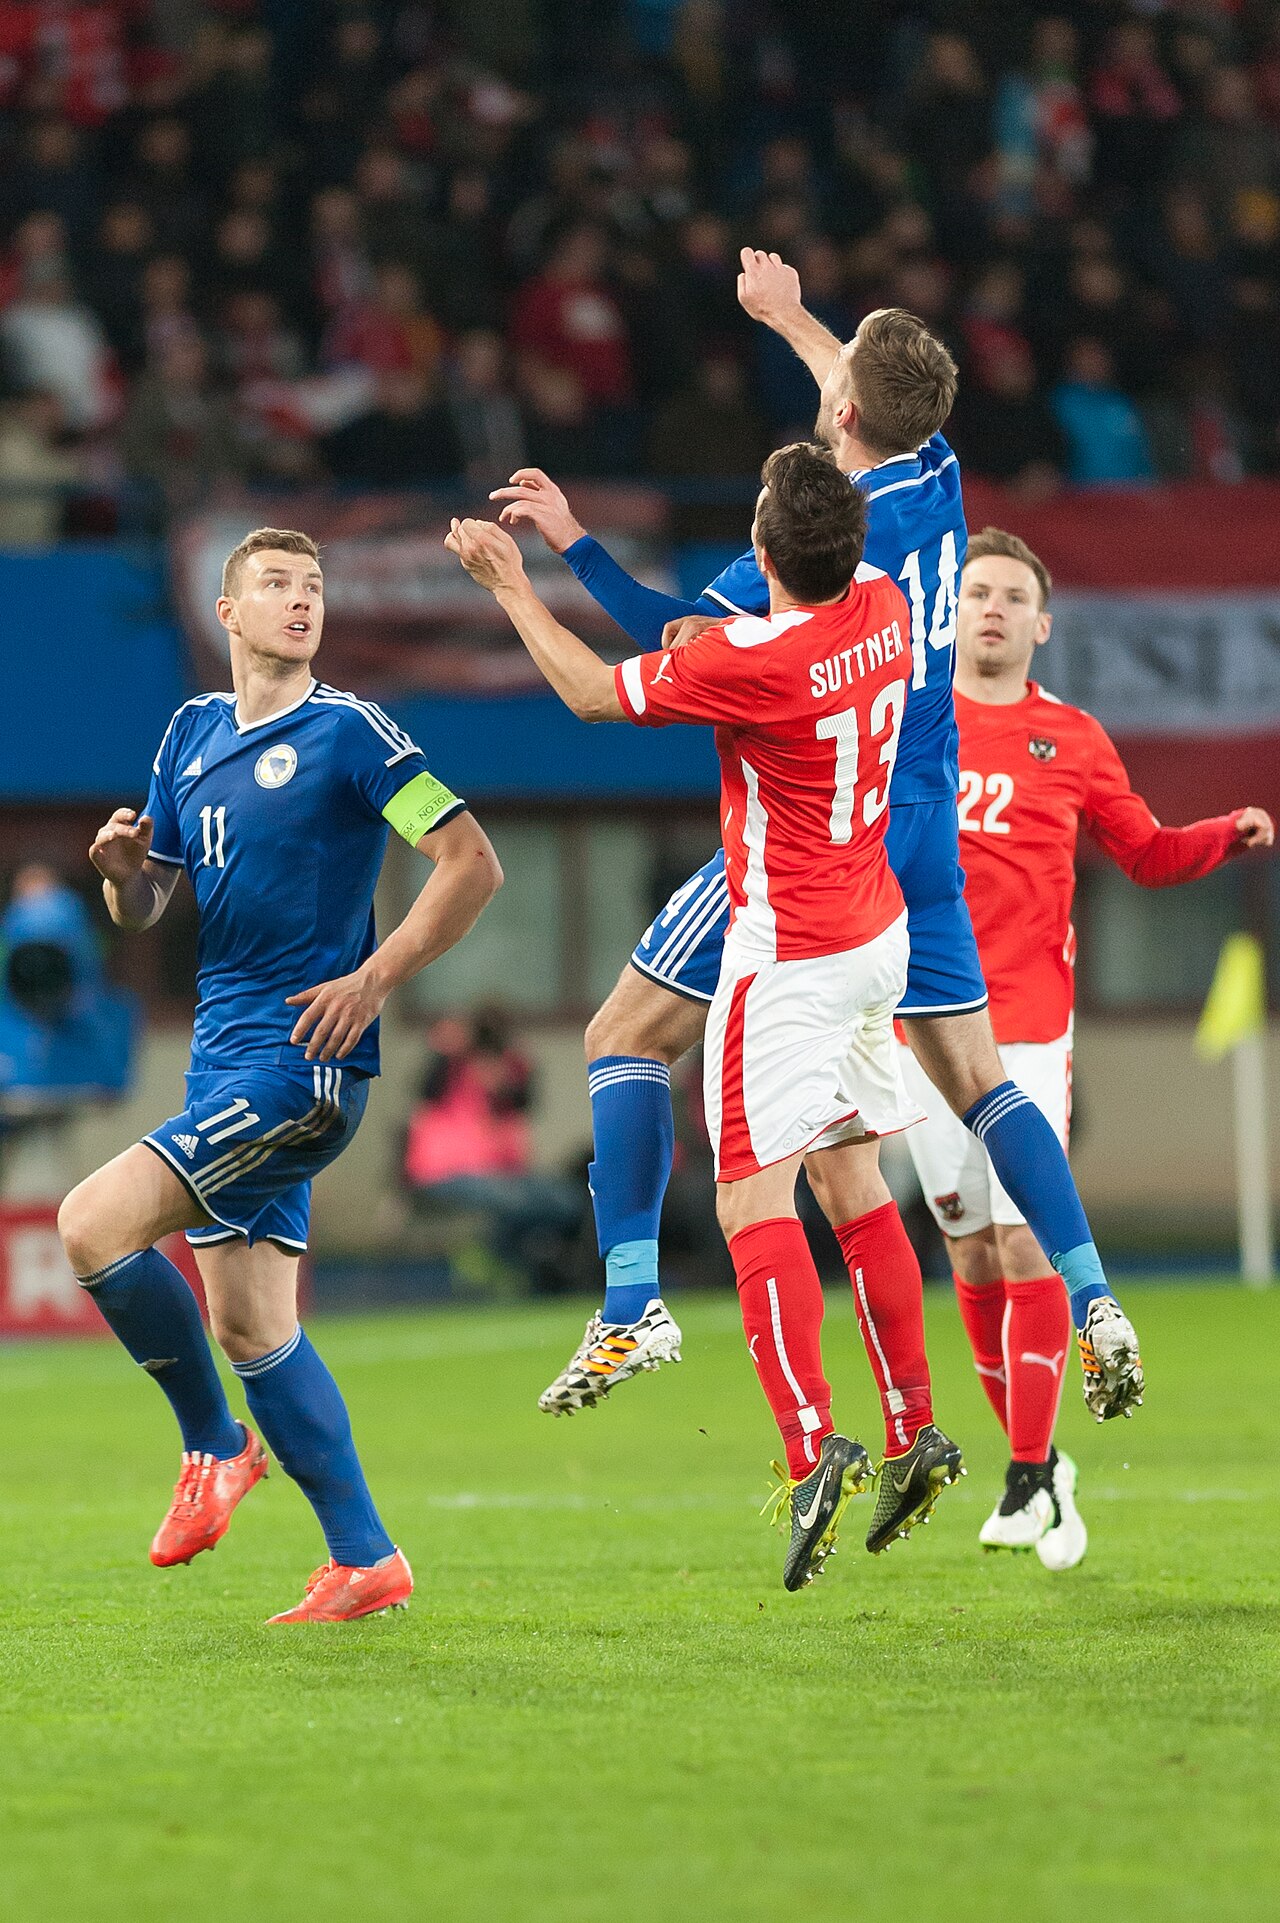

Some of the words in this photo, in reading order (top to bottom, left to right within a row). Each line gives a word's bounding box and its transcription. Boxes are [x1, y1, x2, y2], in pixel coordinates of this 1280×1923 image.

[898, 530, 959, 691] 14
[808, 620, 904, 698] SUTTNER
[815, 678, 906, 844] 13
[418, 805, 434, 820] NO
[434, 797, 446, 807] TO
[957, 770, 1014, 834] 22
[199, 805, 226, 868] 11
[195, 1098, 261, 1145] 11
